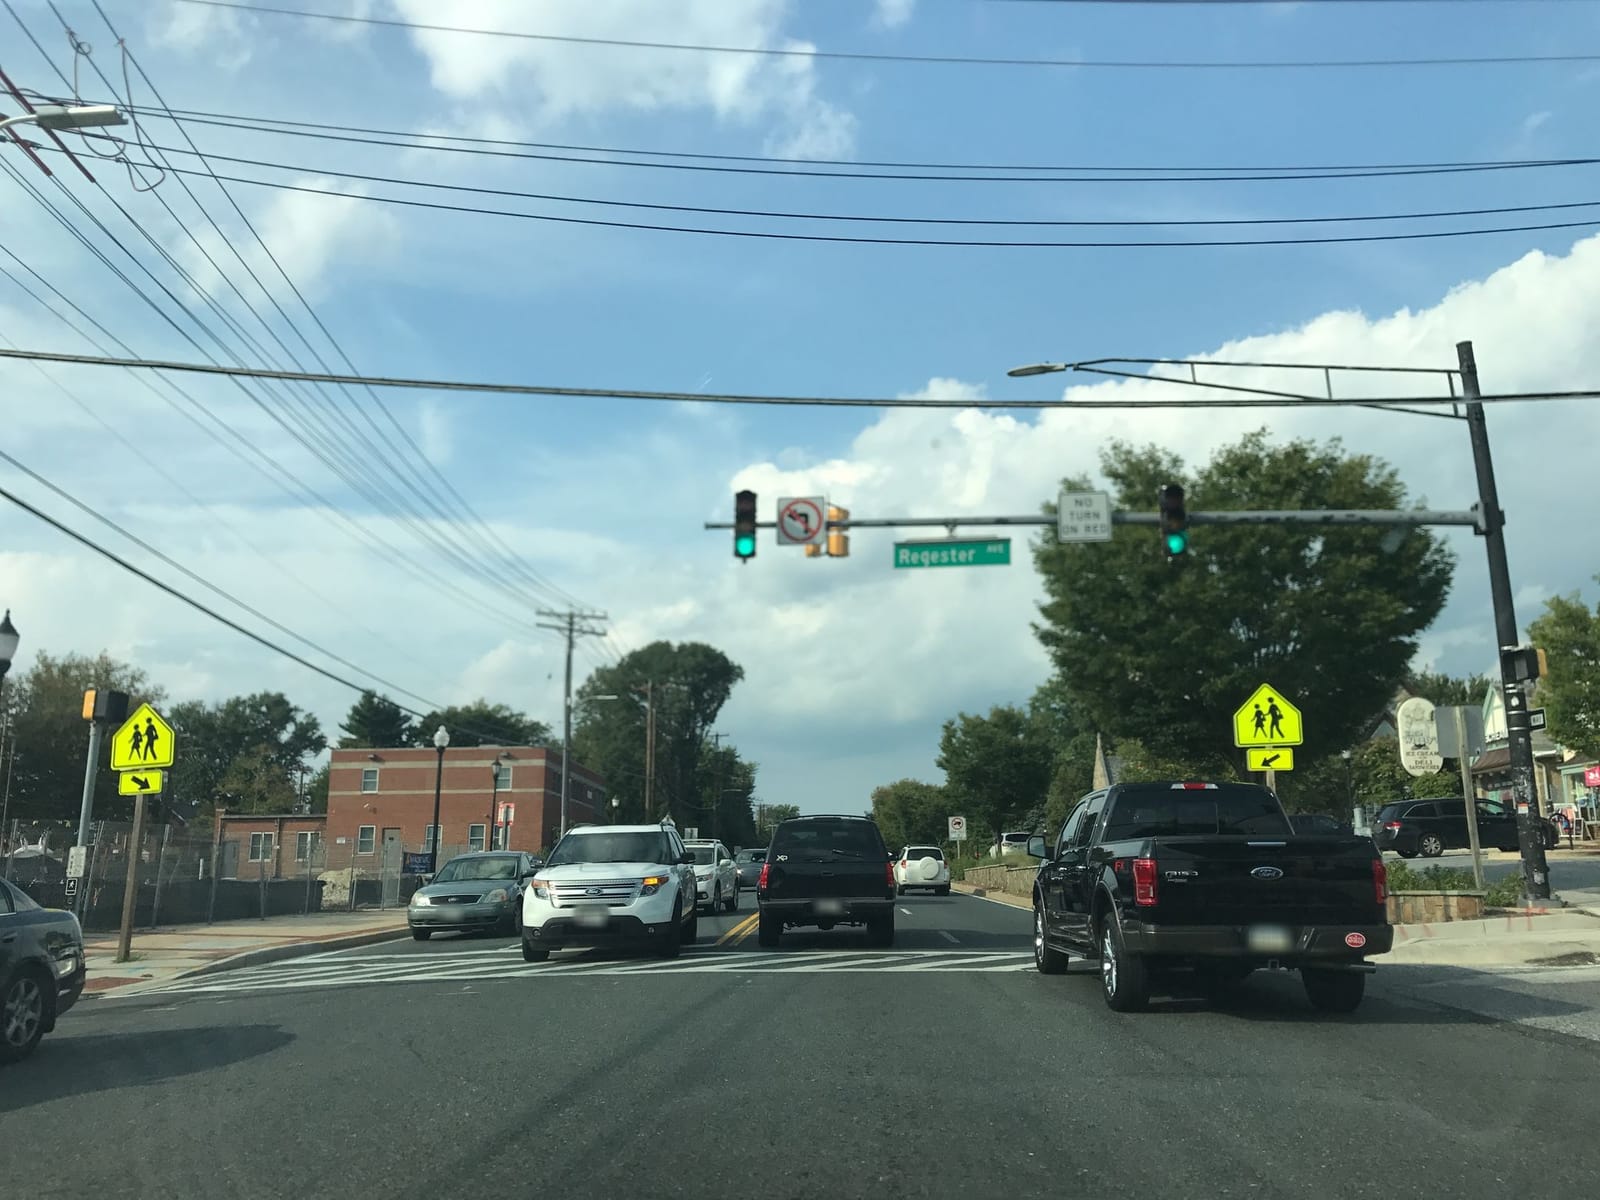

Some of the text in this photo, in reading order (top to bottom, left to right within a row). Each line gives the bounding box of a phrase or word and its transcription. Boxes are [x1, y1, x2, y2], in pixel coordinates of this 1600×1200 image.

[1074, 498, 1093, 508] NO
[1069, 511, 1100, 521] TURN
[1062, 523, 1106, 535] ON RED
[899, 548, 976, 567] Regester
